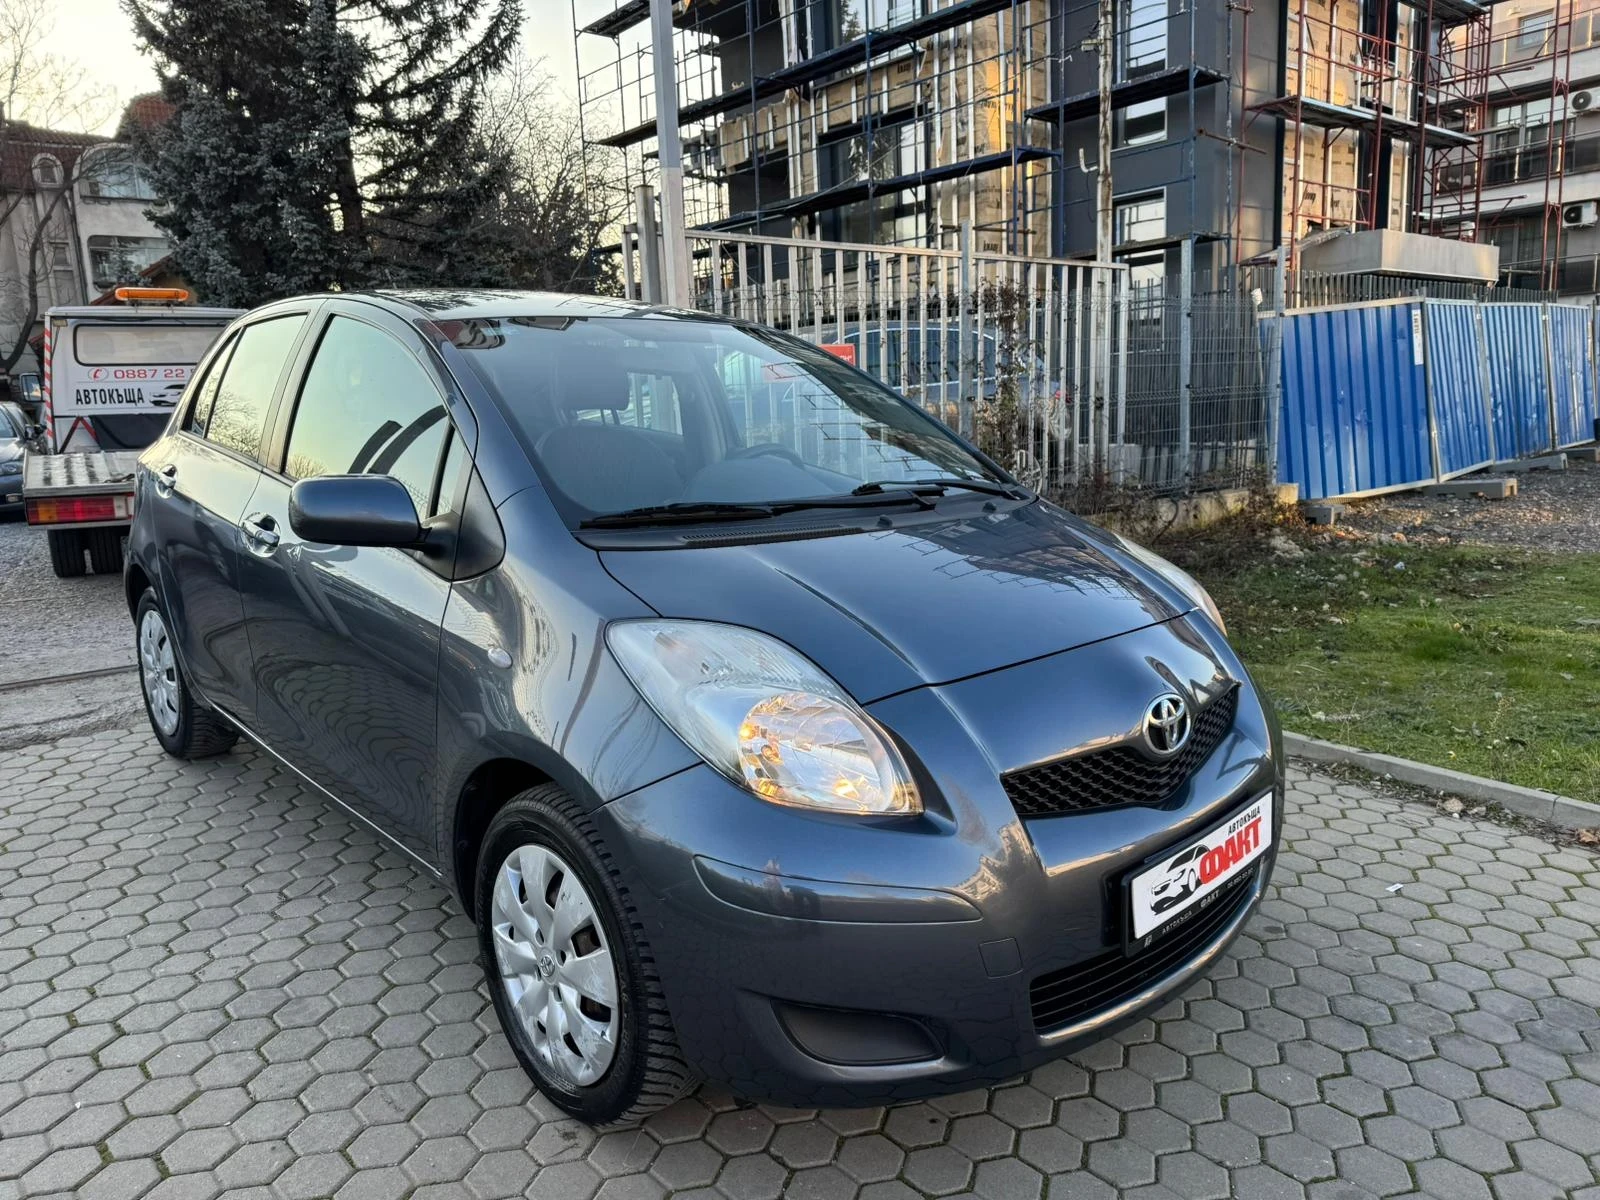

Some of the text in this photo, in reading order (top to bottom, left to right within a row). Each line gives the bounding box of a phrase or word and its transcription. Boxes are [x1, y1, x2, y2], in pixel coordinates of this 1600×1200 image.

[113, 368, 158, 379] 0887
[163, 368, 185, 379] 22
[75, 388, 145, 406] АВТОКЪЩА
[1228, 805, 1261, 836] АВТОКЪЩА
[1200, 816, 1262, 885] ФАКТ
